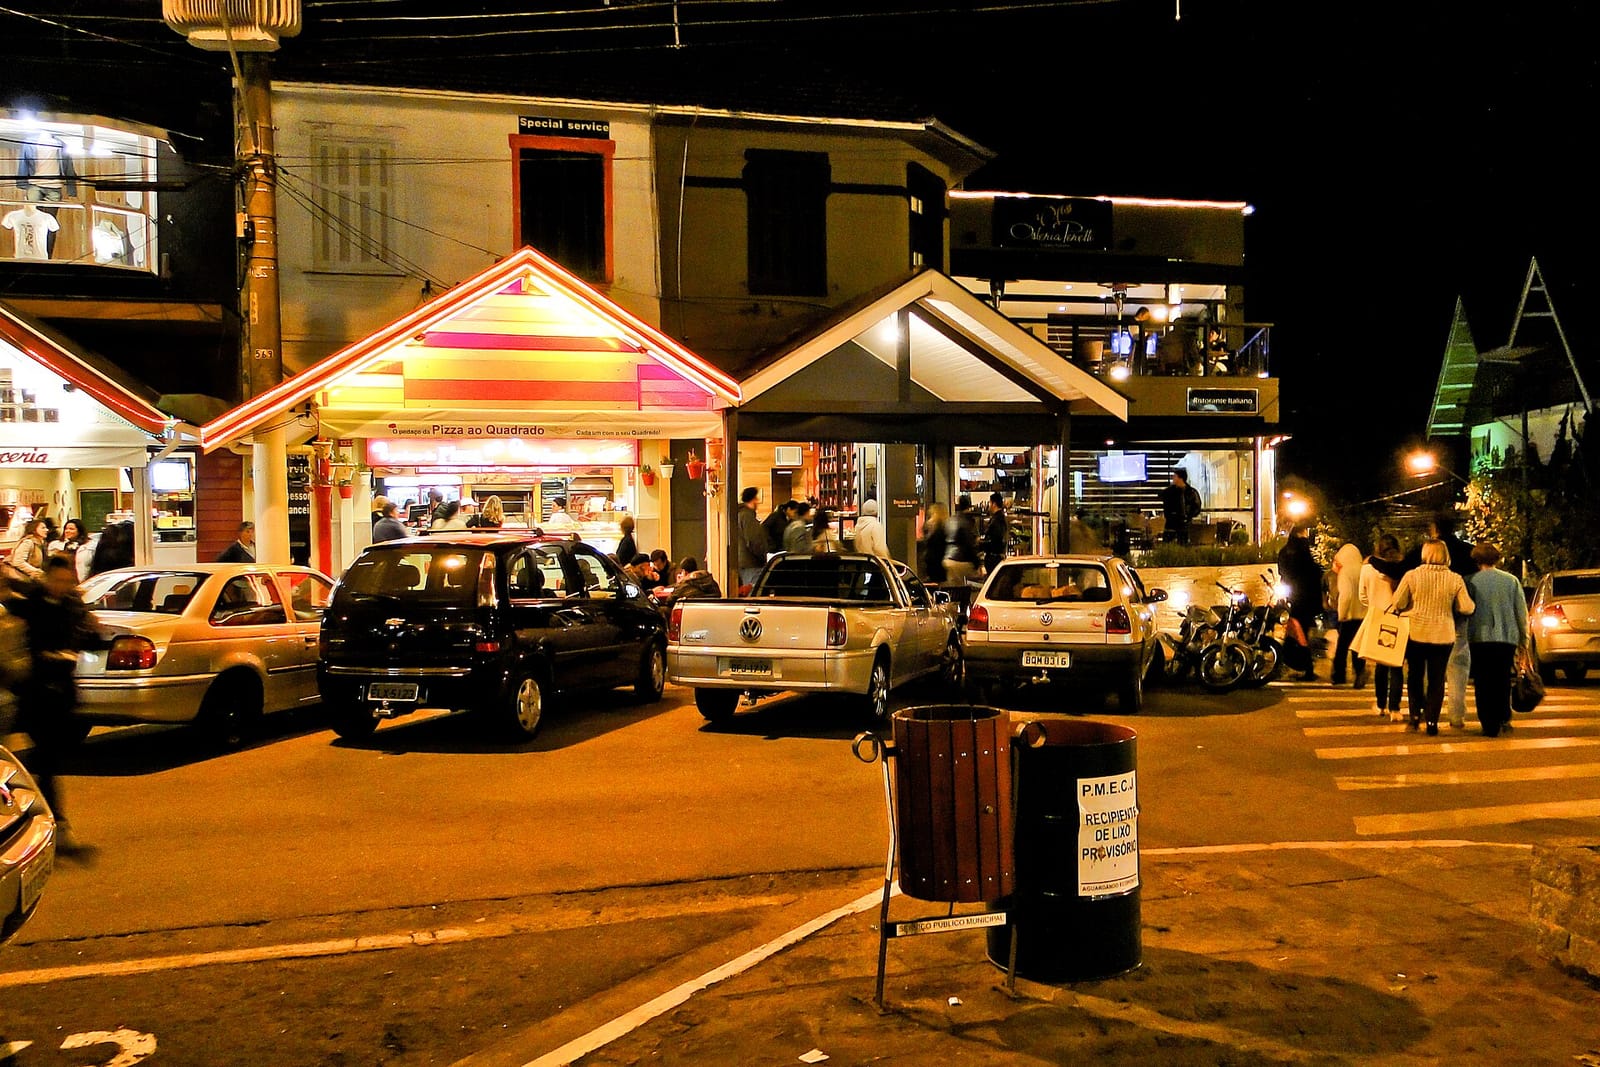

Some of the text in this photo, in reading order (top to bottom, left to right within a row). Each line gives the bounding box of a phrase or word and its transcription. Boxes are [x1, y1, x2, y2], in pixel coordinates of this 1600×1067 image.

[520, 117, 609, 132] Special service
[255, 349, 273, 359] 569
[1228, 397, 1253, 405] Italiano
[432, 424, 463, 435] Pizza
[467, 425, 482, 435] ao
[486, 424, 545, 435] Quadrado
[1086, 806, 1137, 826] RECIPIENTE
[1095, 824, 1131, 842] DE LIXO
[966, 915, 1004, 926] MUNICIPAL
